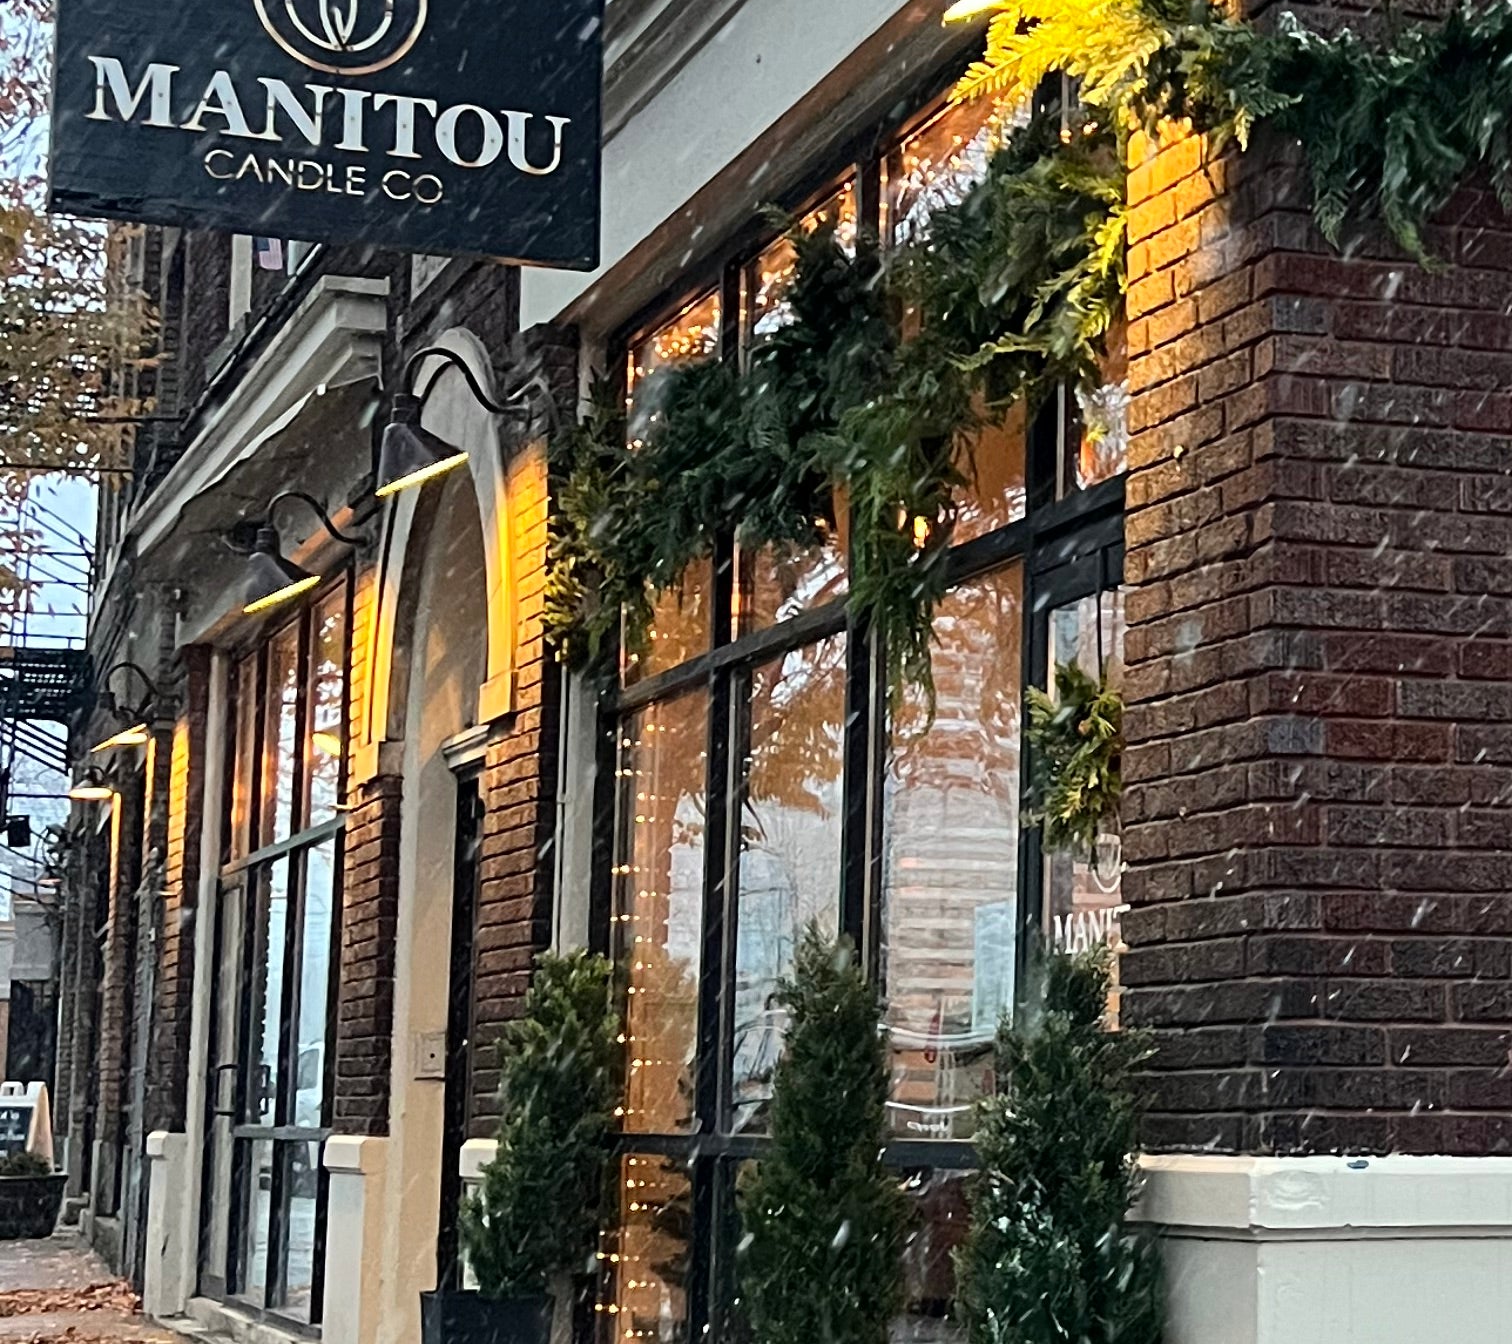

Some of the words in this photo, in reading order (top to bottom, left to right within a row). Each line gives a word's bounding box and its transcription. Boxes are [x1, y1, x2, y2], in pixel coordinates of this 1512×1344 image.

[86, 56, 571, 177] MANITOU
[204, 149, 365, 196] CANDLE
[382, 170, 443, 204] CO
